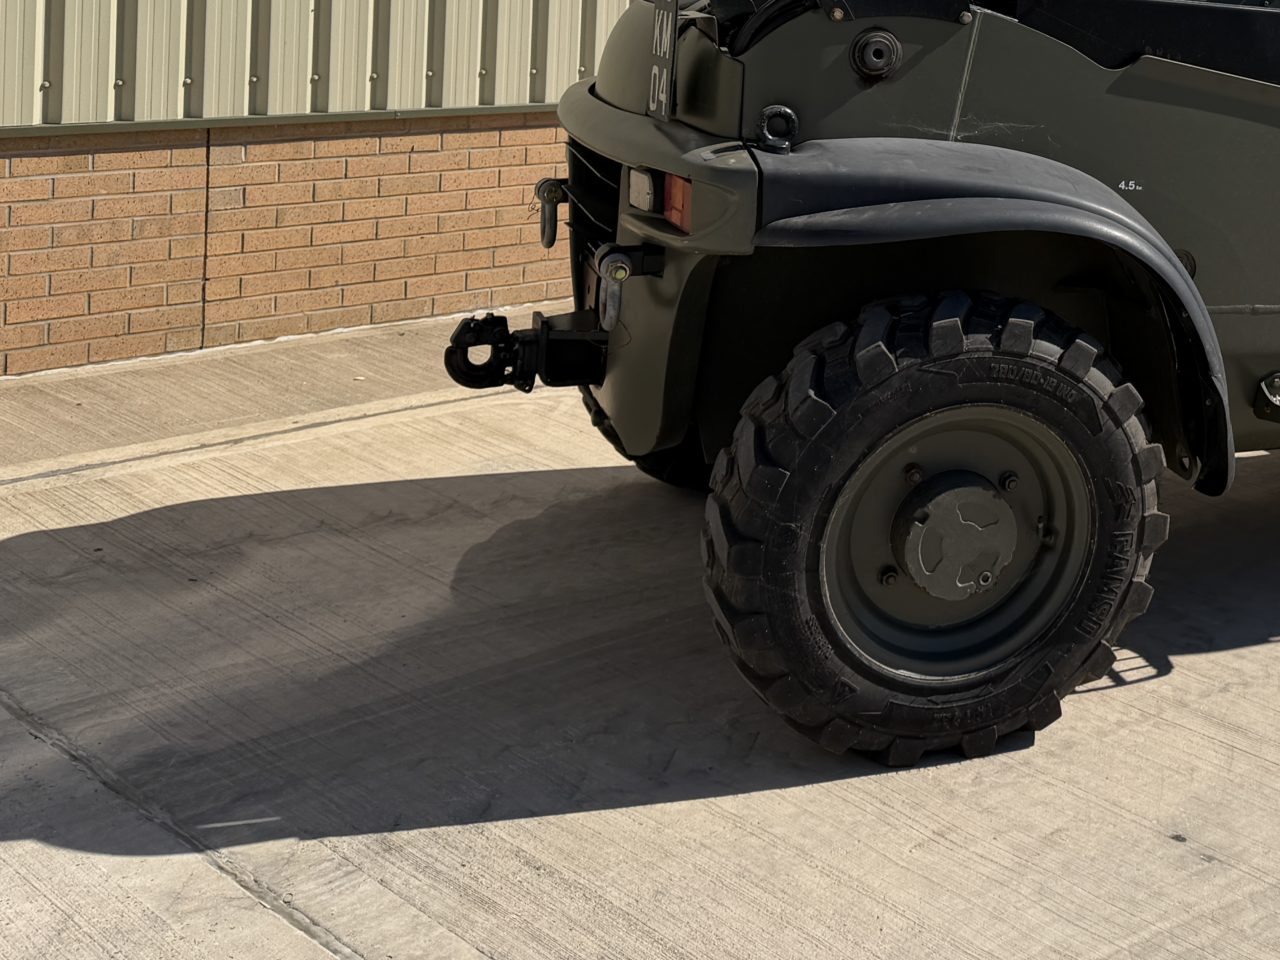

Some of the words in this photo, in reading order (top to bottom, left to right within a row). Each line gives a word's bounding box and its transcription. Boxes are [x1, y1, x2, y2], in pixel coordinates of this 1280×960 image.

[652, 9, 672, 59] KM
[649, 64, 667, 116] 04
[1118, 180, 1136, 191] 4.5
